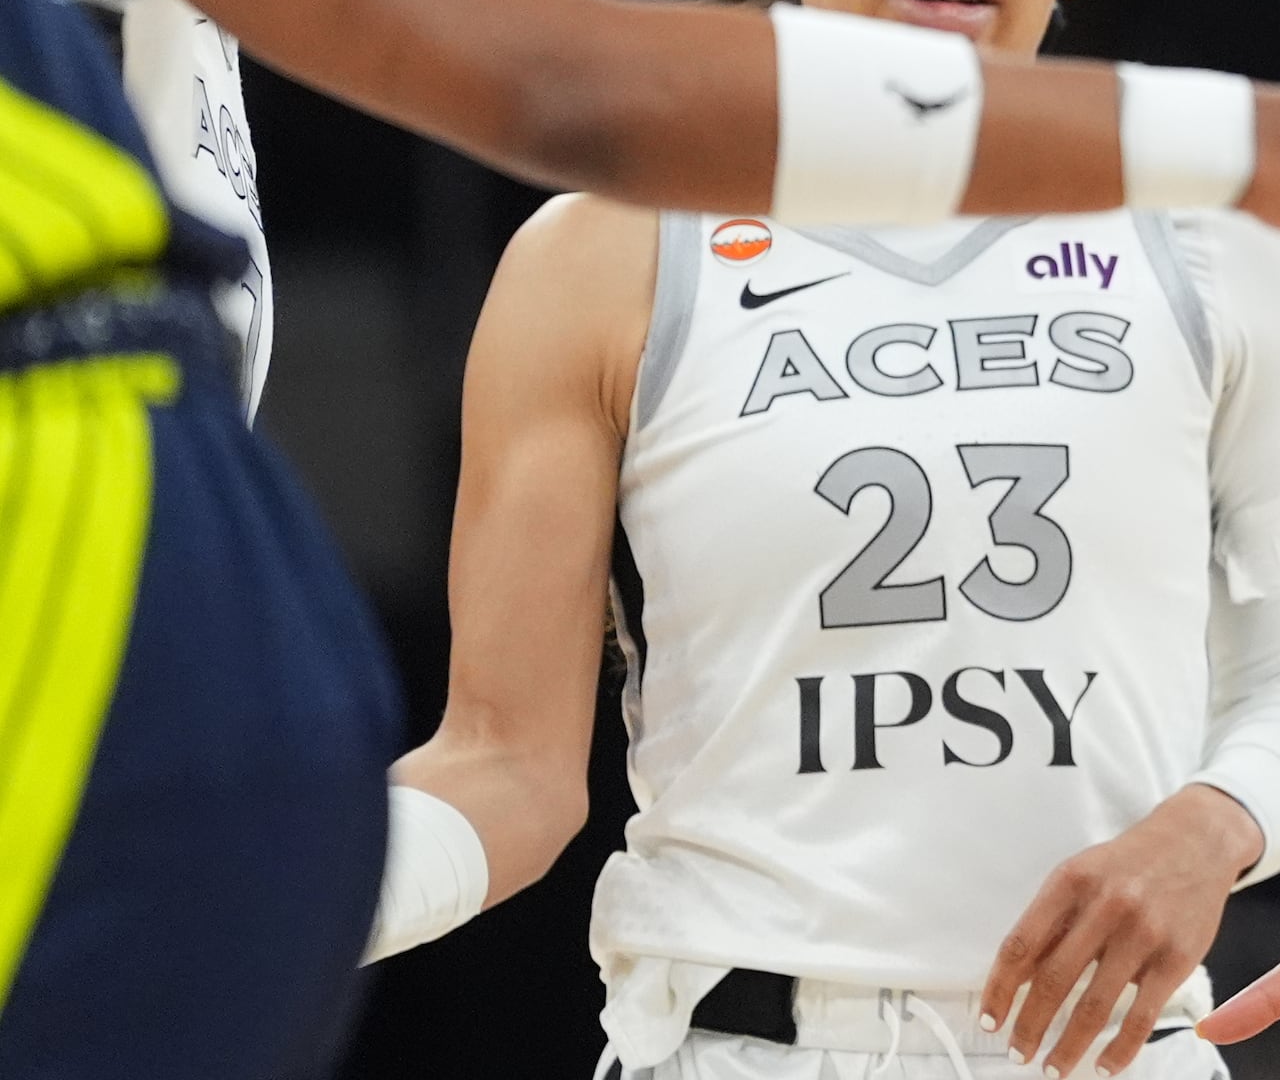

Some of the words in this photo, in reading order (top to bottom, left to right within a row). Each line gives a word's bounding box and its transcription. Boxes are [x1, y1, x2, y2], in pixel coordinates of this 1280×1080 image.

[1026, 242, 1119, 289] ally
[739, 311, 1134, 419] ACES
[814, 443, 1073, 629] 23
[795, 666, 1099, 775] IPSY
